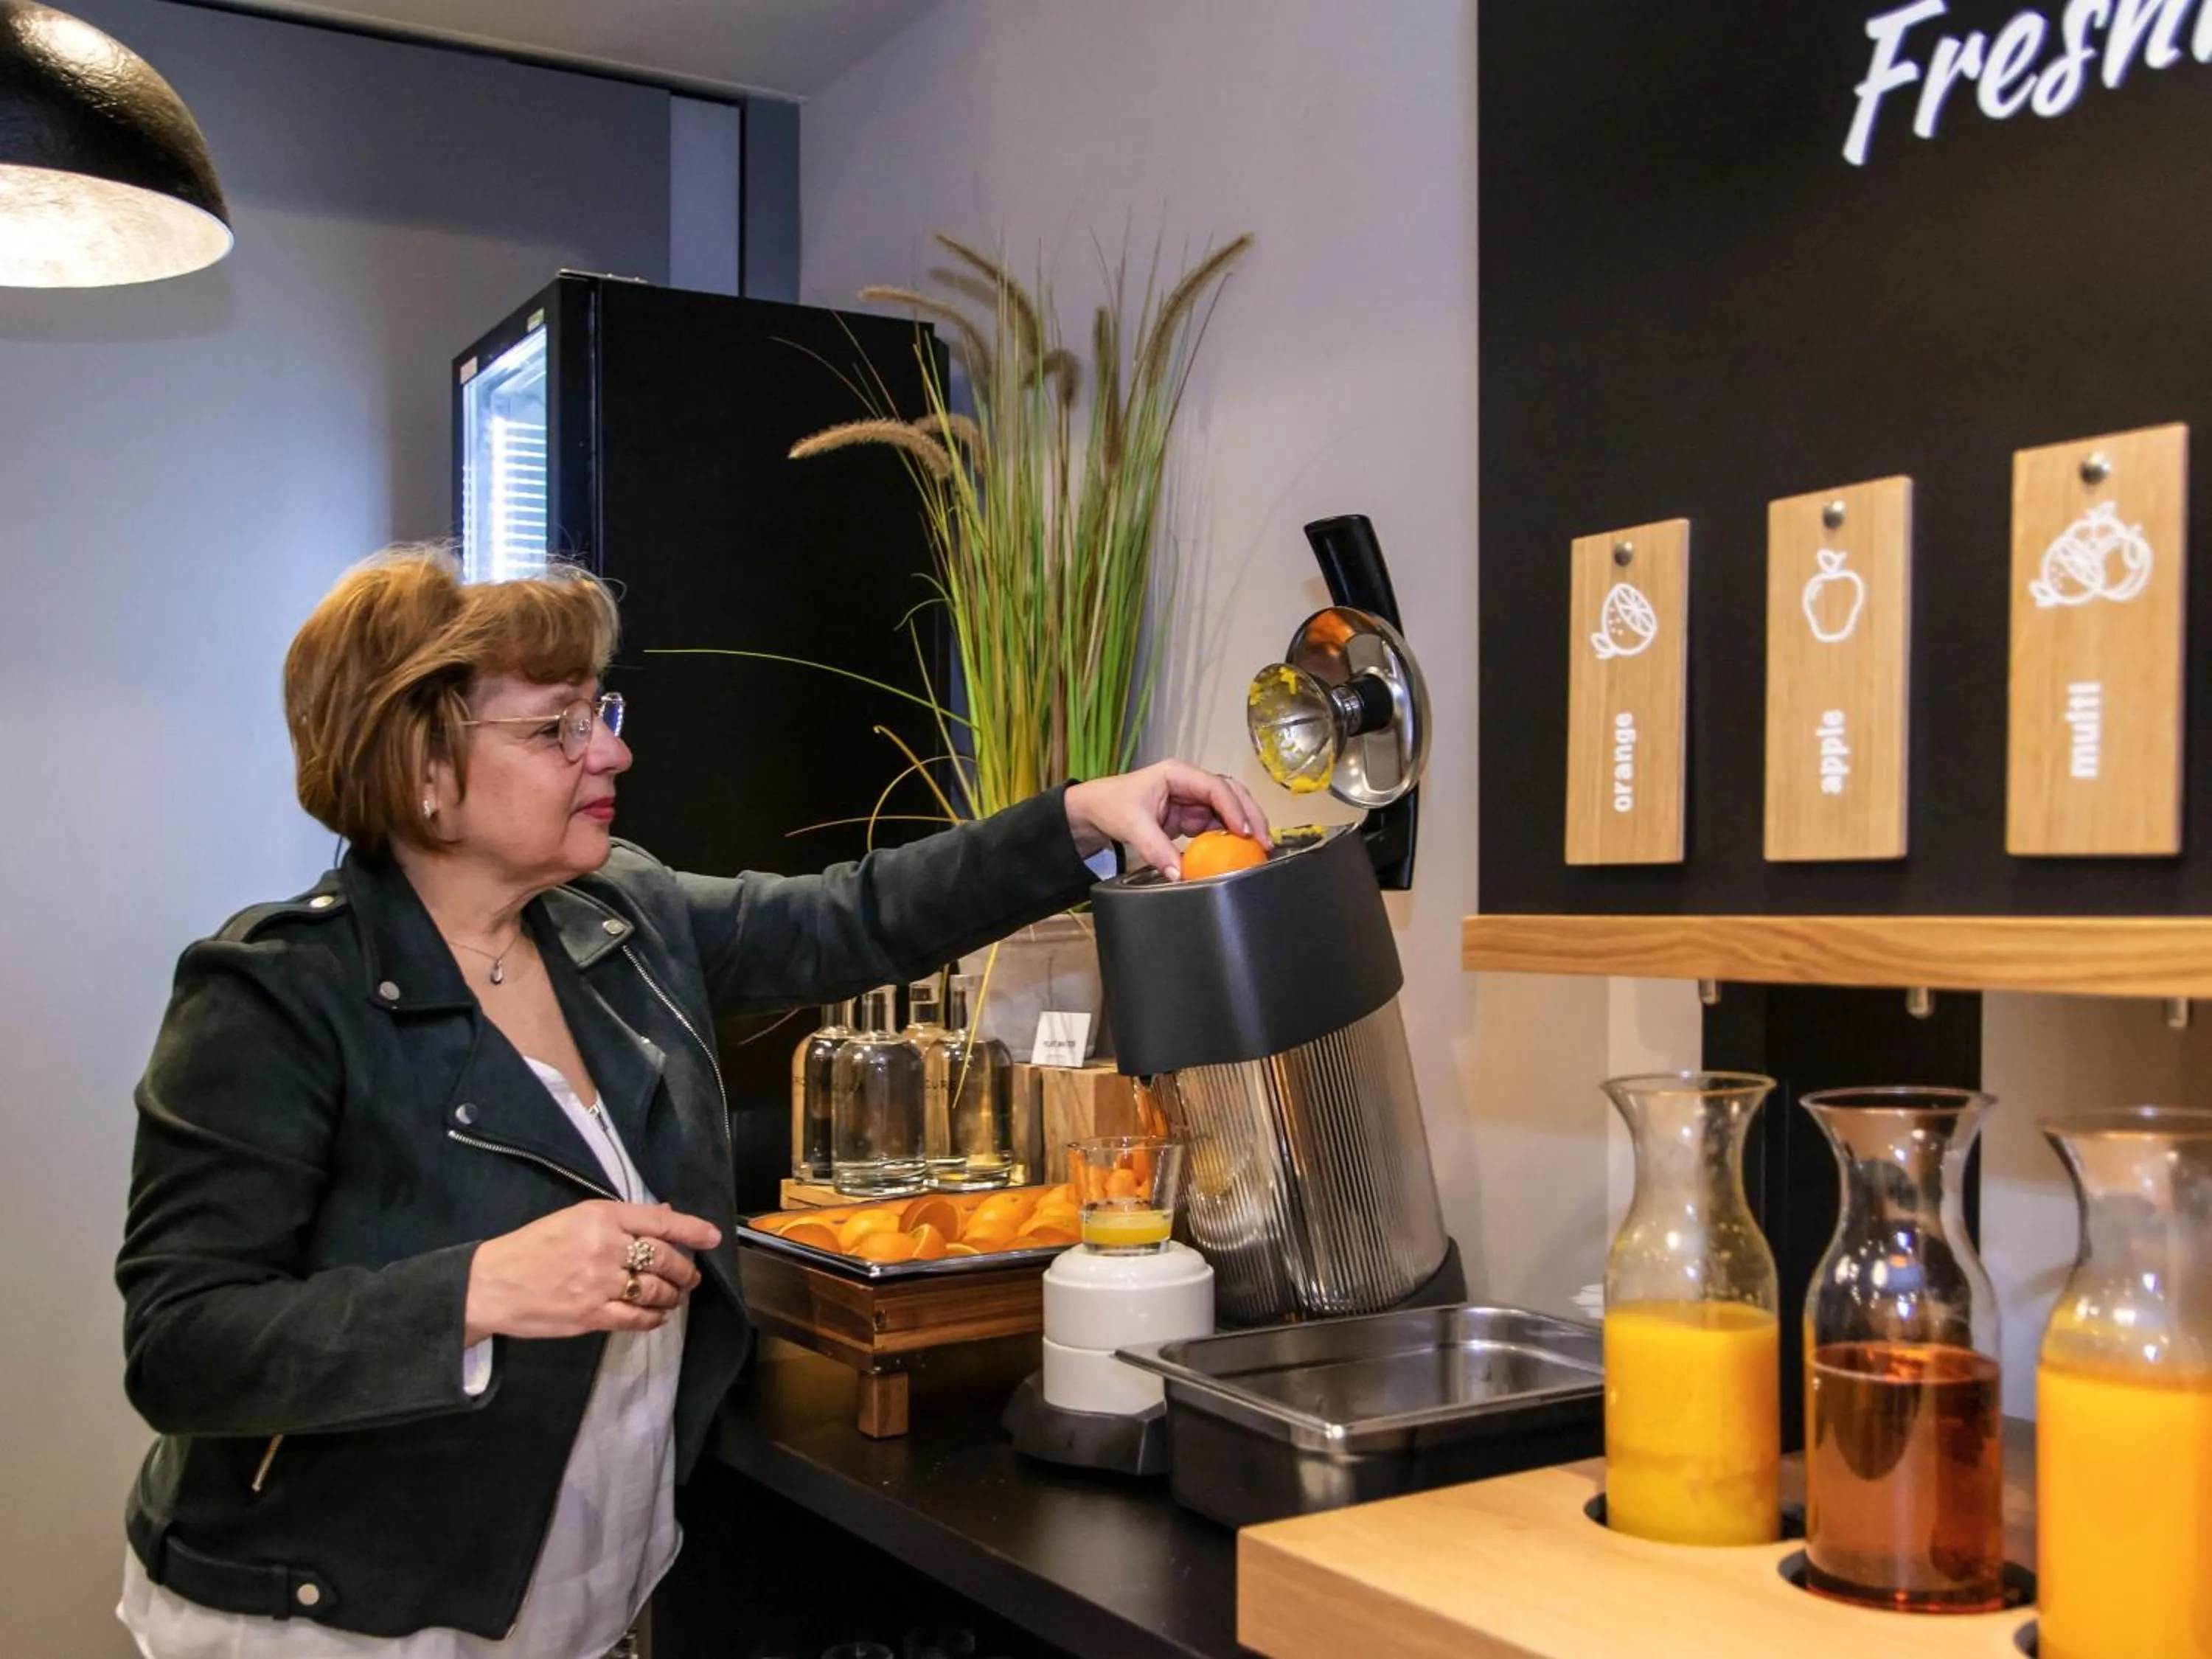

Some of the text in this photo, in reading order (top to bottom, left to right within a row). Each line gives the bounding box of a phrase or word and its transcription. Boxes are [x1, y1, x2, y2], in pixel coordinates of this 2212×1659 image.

[1843, 0, 2212, 166] Fresh
[1613, 712, 1638, 813] orange
[1815, 709, 1851, 795] apple
[2064, 681, 2103, 778] multi
